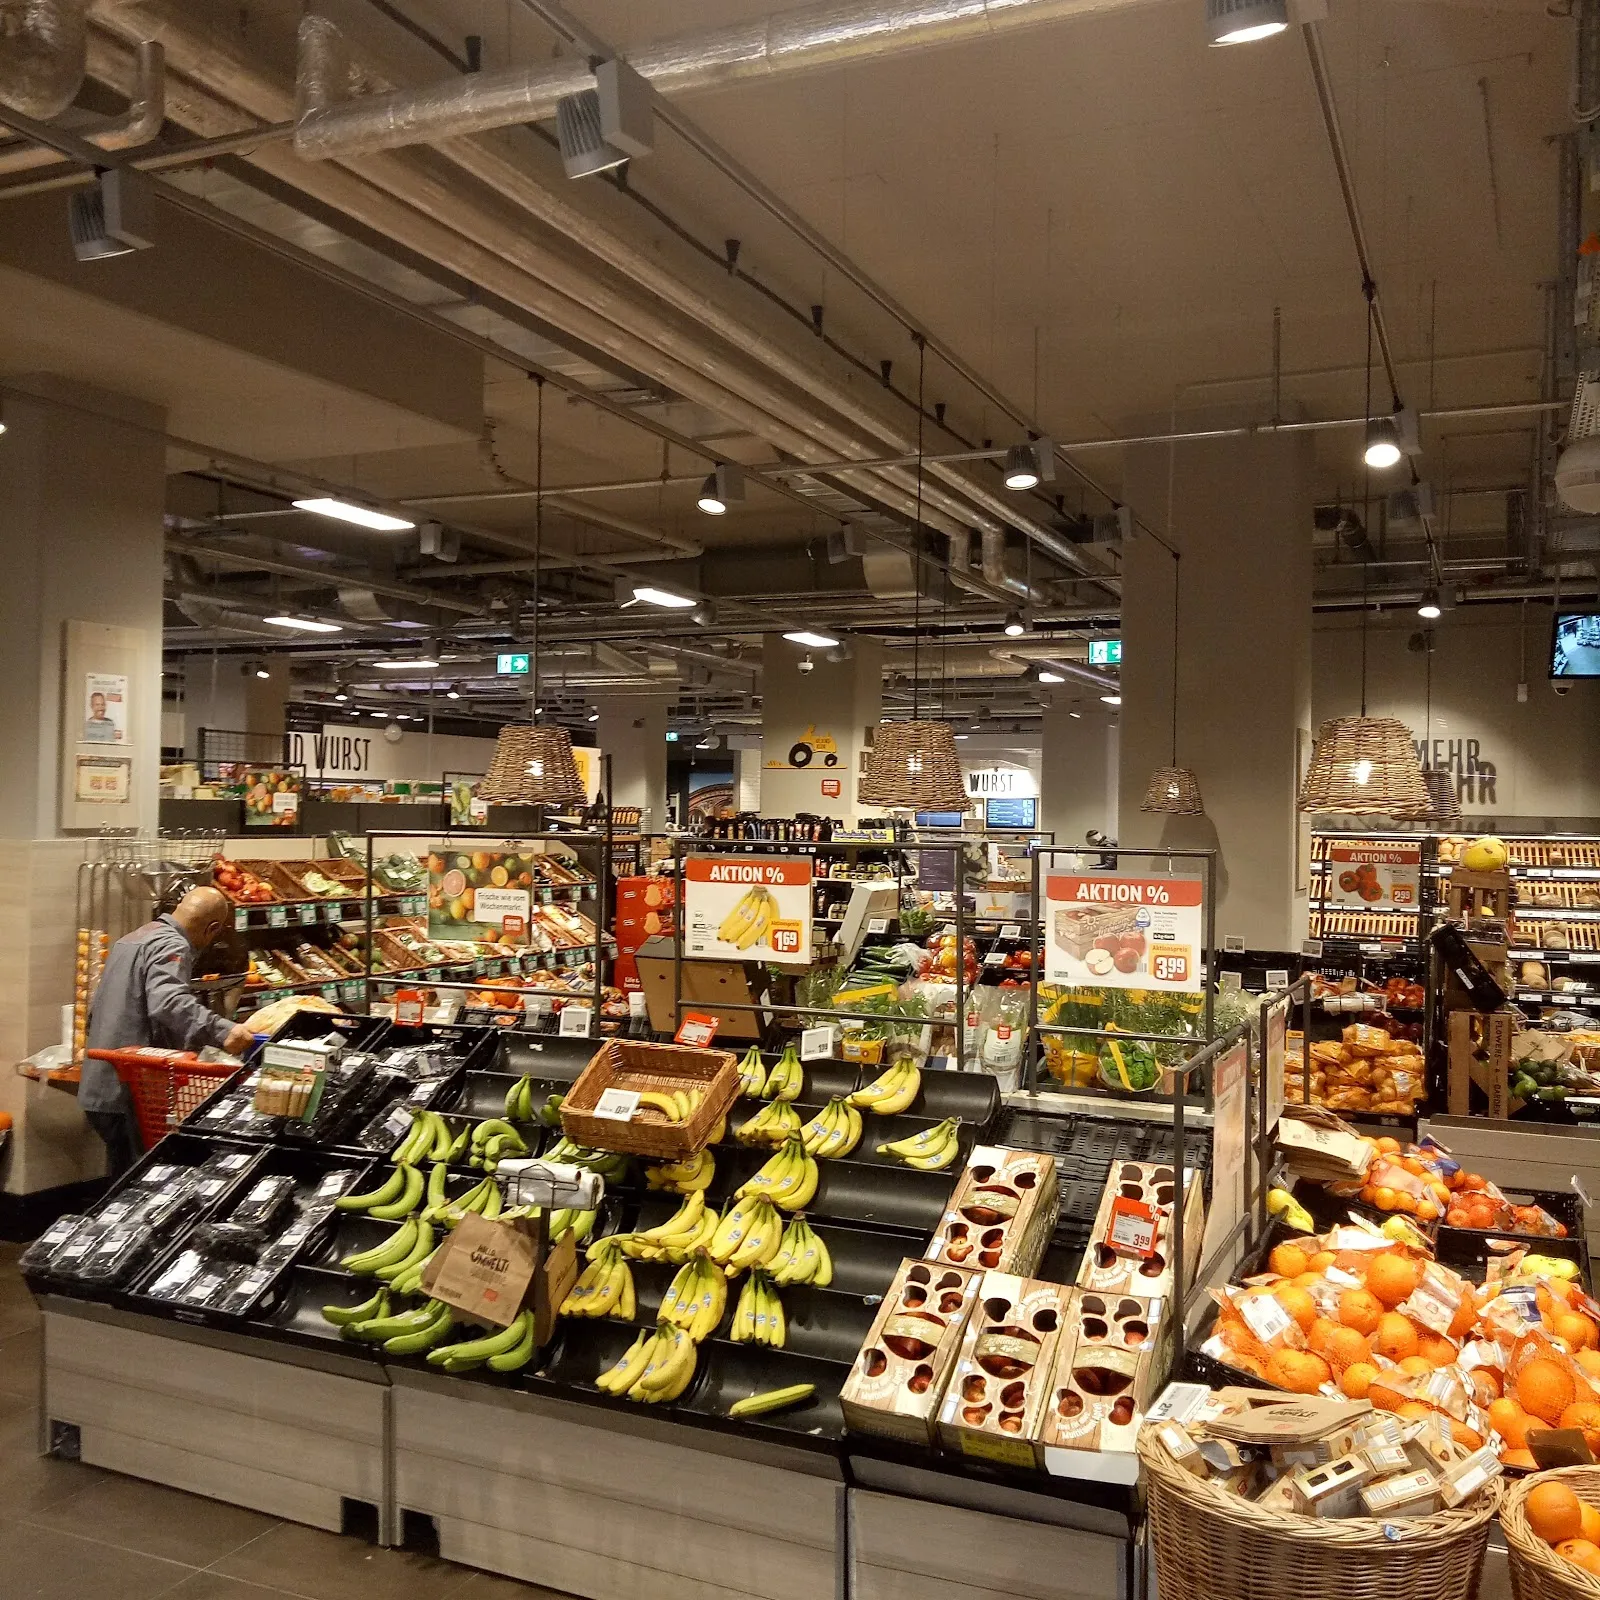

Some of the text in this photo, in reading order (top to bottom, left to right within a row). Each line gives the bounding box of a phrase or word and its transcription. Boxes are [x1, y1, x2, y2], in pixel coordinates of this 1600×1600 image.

[314, 734, 371, 771] WURST
[1412, 739, 1480, 772] MEHR
[969, 773, 1013, 792] WURST
[1349, 852, 1402, 863] AKTION %
[710, 865, 784, 883] AKTION %
[1076, 883, 1169, 903] AKTION %
[774, 931, 797, 951] 1.69
[1152, 945, 1188, 953] Aktionspreis
[1156, 957, 1185, 978] 3.99
[1494, 1020, 1503, 1058] FLOWERS
[1494, 1084, 1502, 1115] GARDEN
[1133, 1233, 1150, 1247] 3.99
